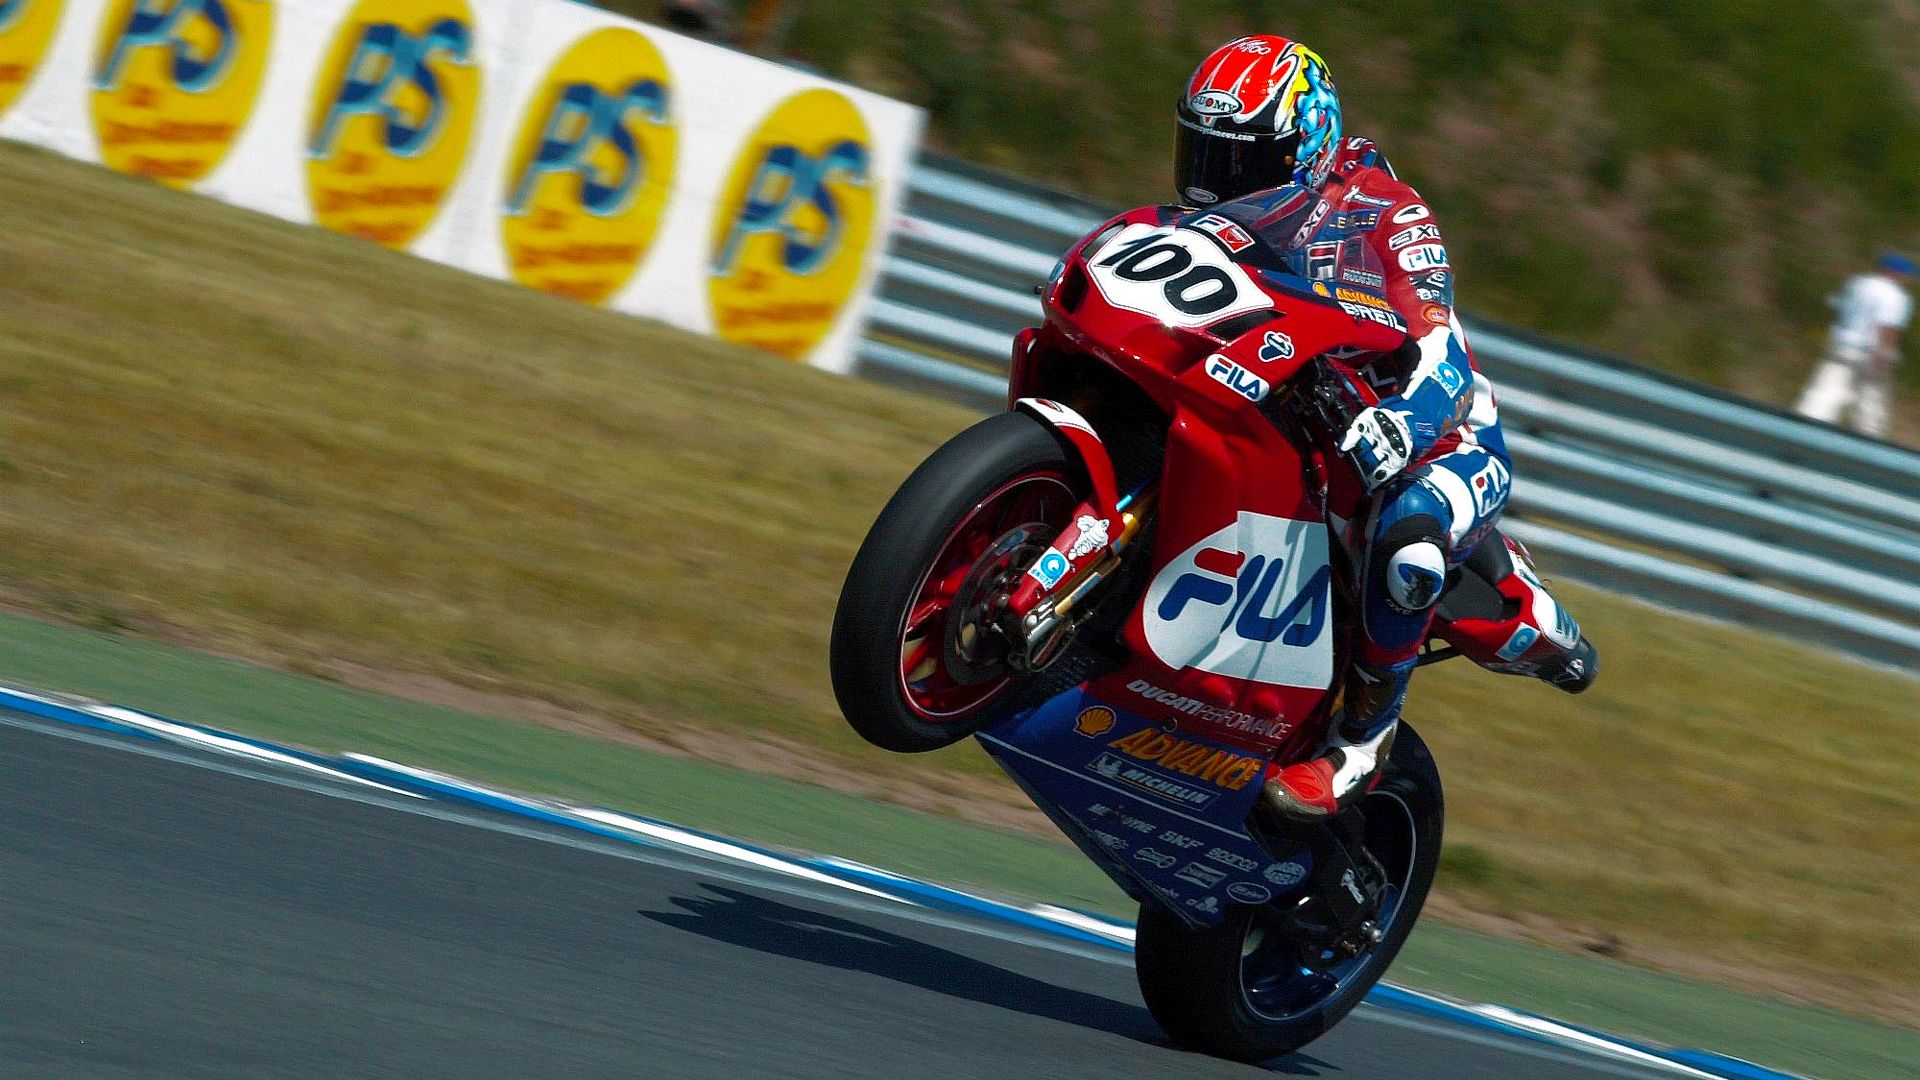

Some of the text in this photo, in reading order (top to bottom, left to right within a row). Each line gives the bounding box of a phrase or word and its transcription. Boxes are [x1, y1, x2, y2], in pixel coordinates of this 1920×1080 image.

[304, 18, 474, 159] PS
[502, 78, 669, 216] PS
[709, 139, 873, 276] PS
[1093, 233, 1239, 316] 100
[1338, 301, 1408, 334] BREIL
[1210, 356, 1261, 400] FILA
[1158, 547, 1330, 648] FILA
[1126, 679, 1293, 740] DUCATI PERFORMANCE
[1108, 727, 1265, 791] ADVANCE
[1121, 769, 1211, 804] MICHELIN
